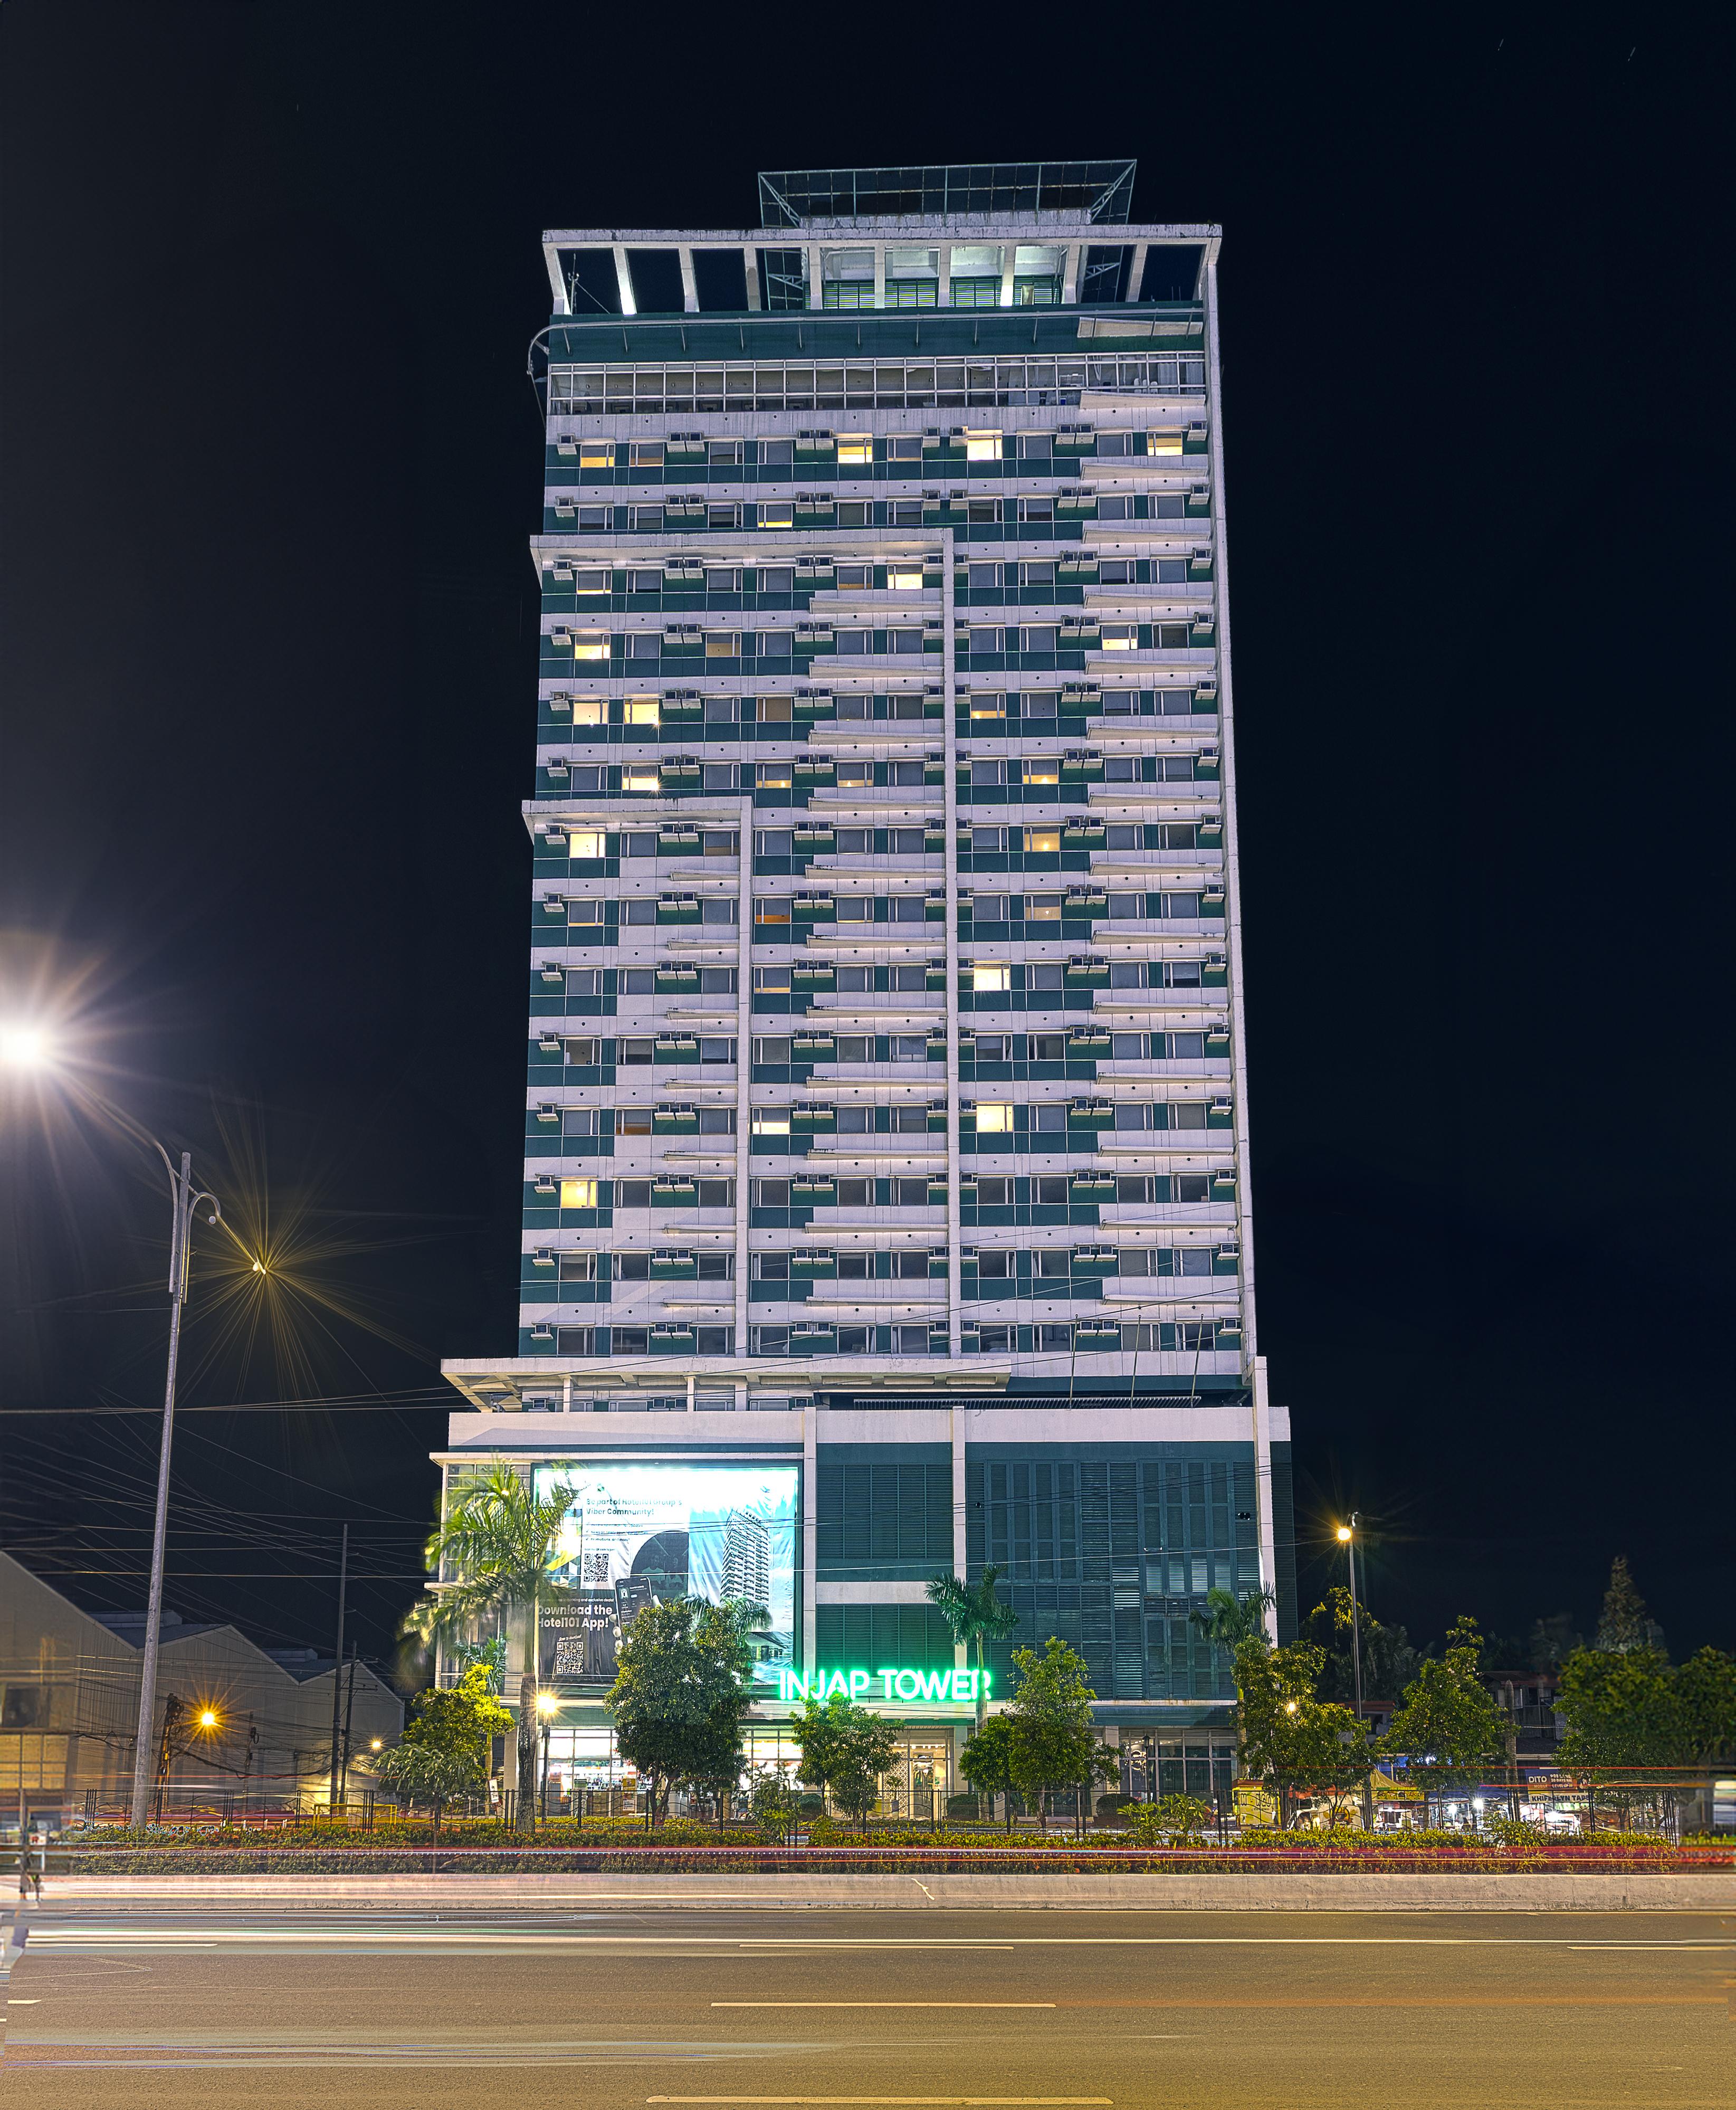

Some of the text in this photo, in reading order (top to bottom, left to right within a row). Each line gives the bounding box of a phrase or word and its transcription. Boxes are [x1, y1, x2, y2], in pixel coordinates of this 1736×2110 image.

[597, 1498, 612, 1507] part
[607, 1508, 654, 1517] Community!
[539, 1604, 613, 1615] Download the
[581, 1617, 609, 1631] App!
[779, 1669, 992, 1700] INJAP TOWER
